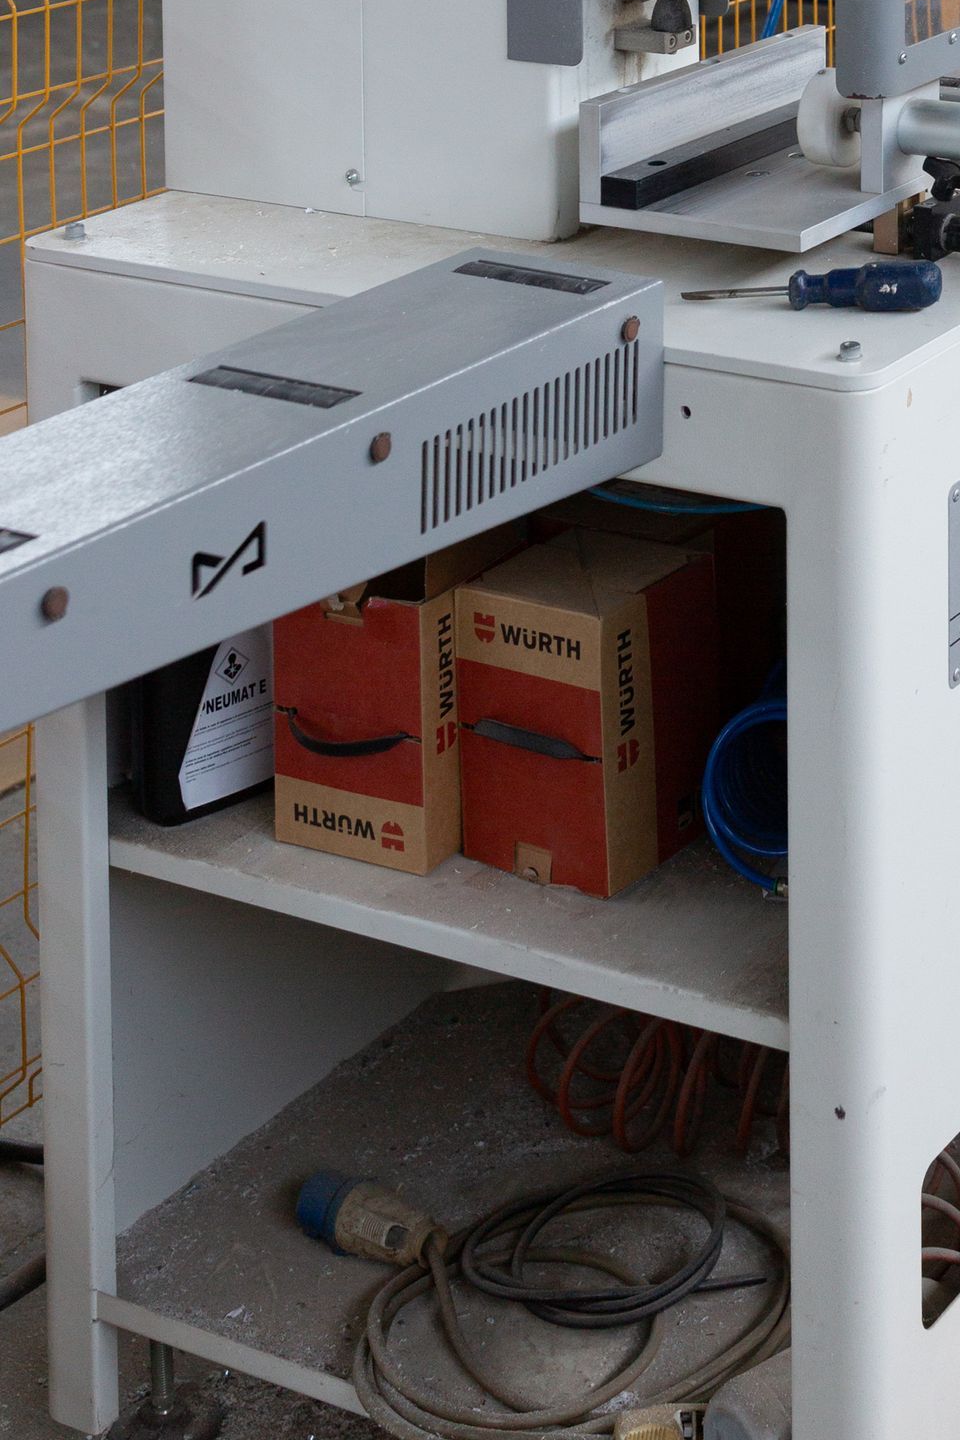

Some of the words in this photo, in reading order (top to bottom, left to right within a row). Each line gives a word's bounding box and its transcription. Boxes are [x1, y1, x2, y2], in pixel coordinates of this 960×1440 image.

[501, 623, 581, 660] WÜRTH
[438, 613, 454, 720] WÜRTH
[617, 629, 635, 736] WÜRTH
[260, 679, 267, 694] E
[294, 803, 376, 840] WÜRTH
